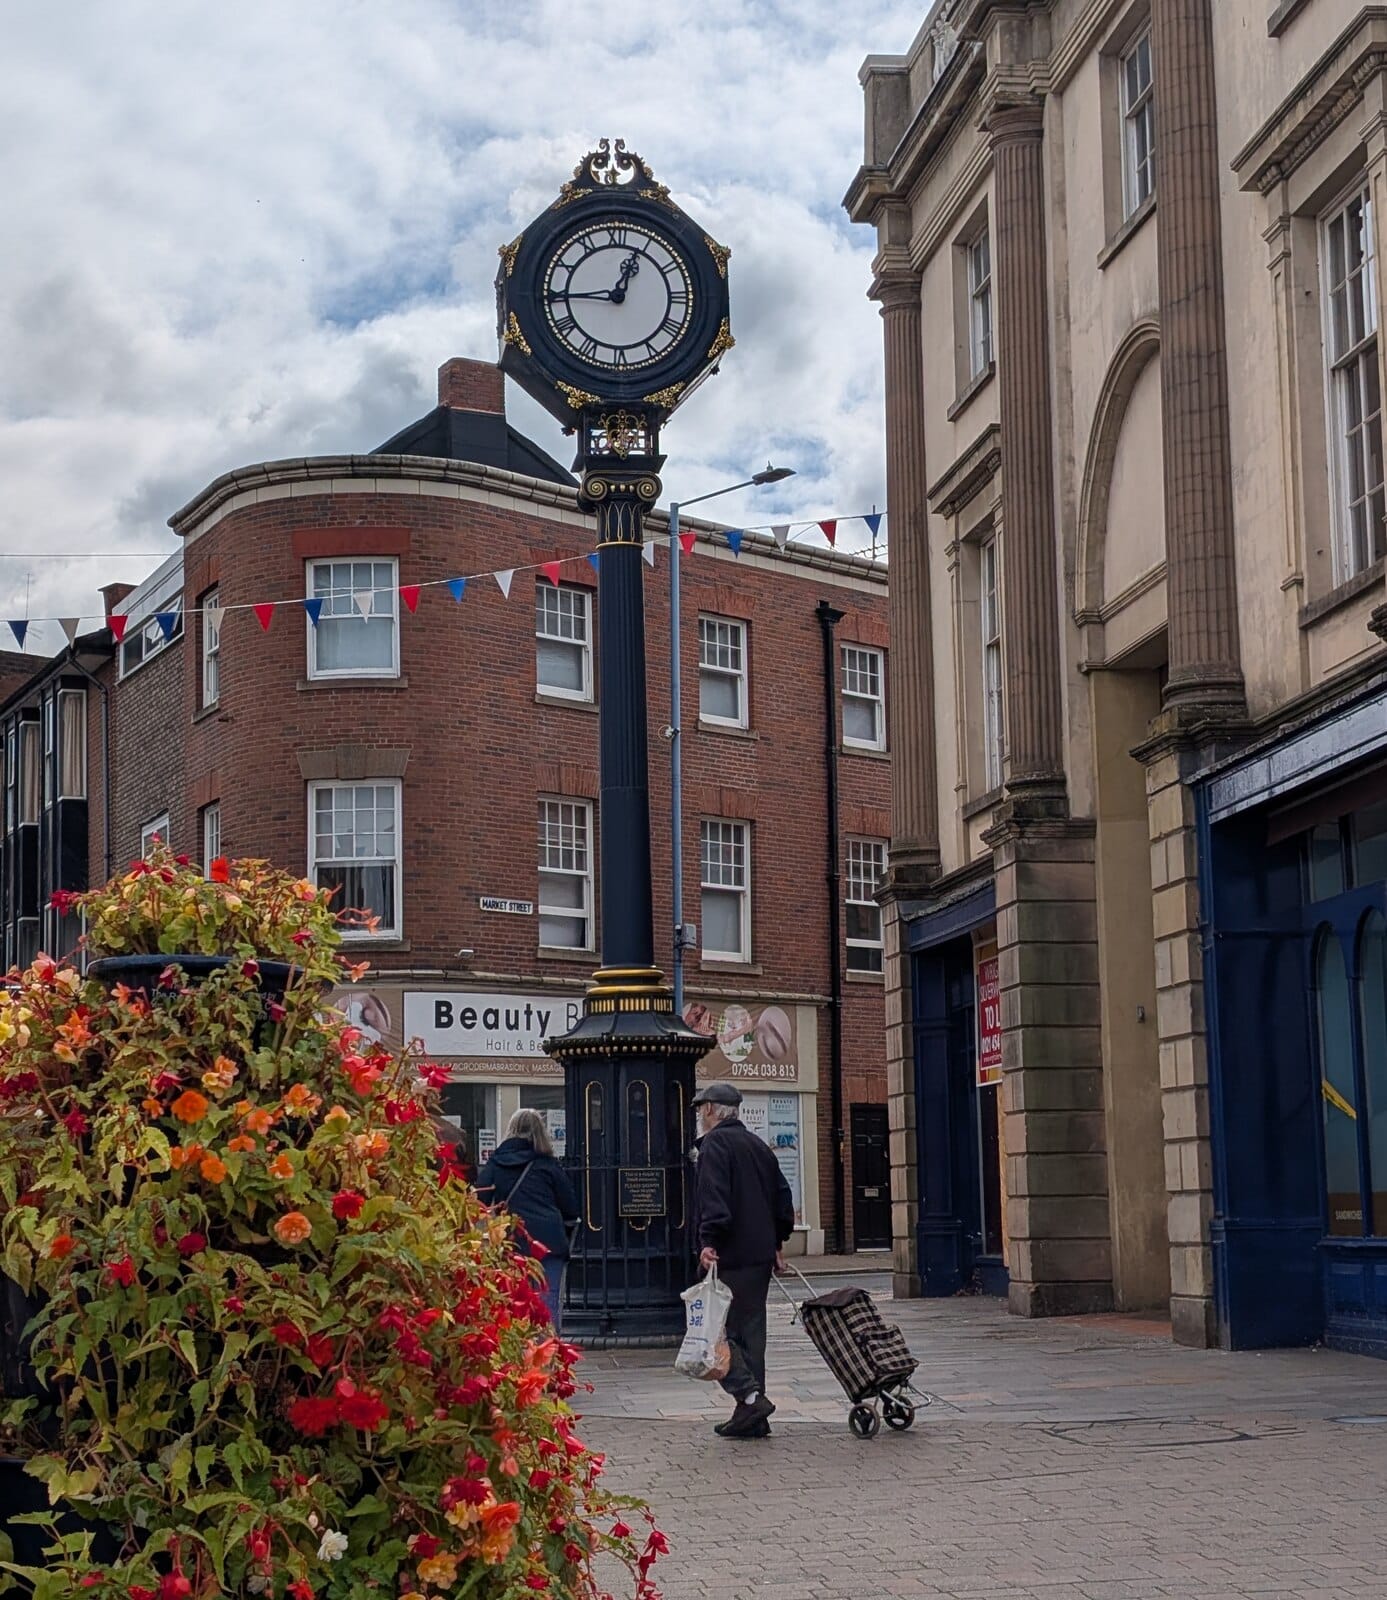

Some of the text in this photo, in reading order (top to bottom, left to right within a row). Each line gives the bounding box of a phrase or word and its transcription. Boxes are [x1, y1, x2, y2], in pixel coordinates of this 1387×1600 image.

[608, 229, 627, 246] XII
[482, 899, 532, 913] MARKET STREET
[434, 1000, 552, 1038] Beauty
[985, 1006, 994, 1030] TO
[486, 1038, 510, 1051] Hair
[516, 1040, 524, 1051] &
[731, 1063, 795, 1078] 07954 038 813
